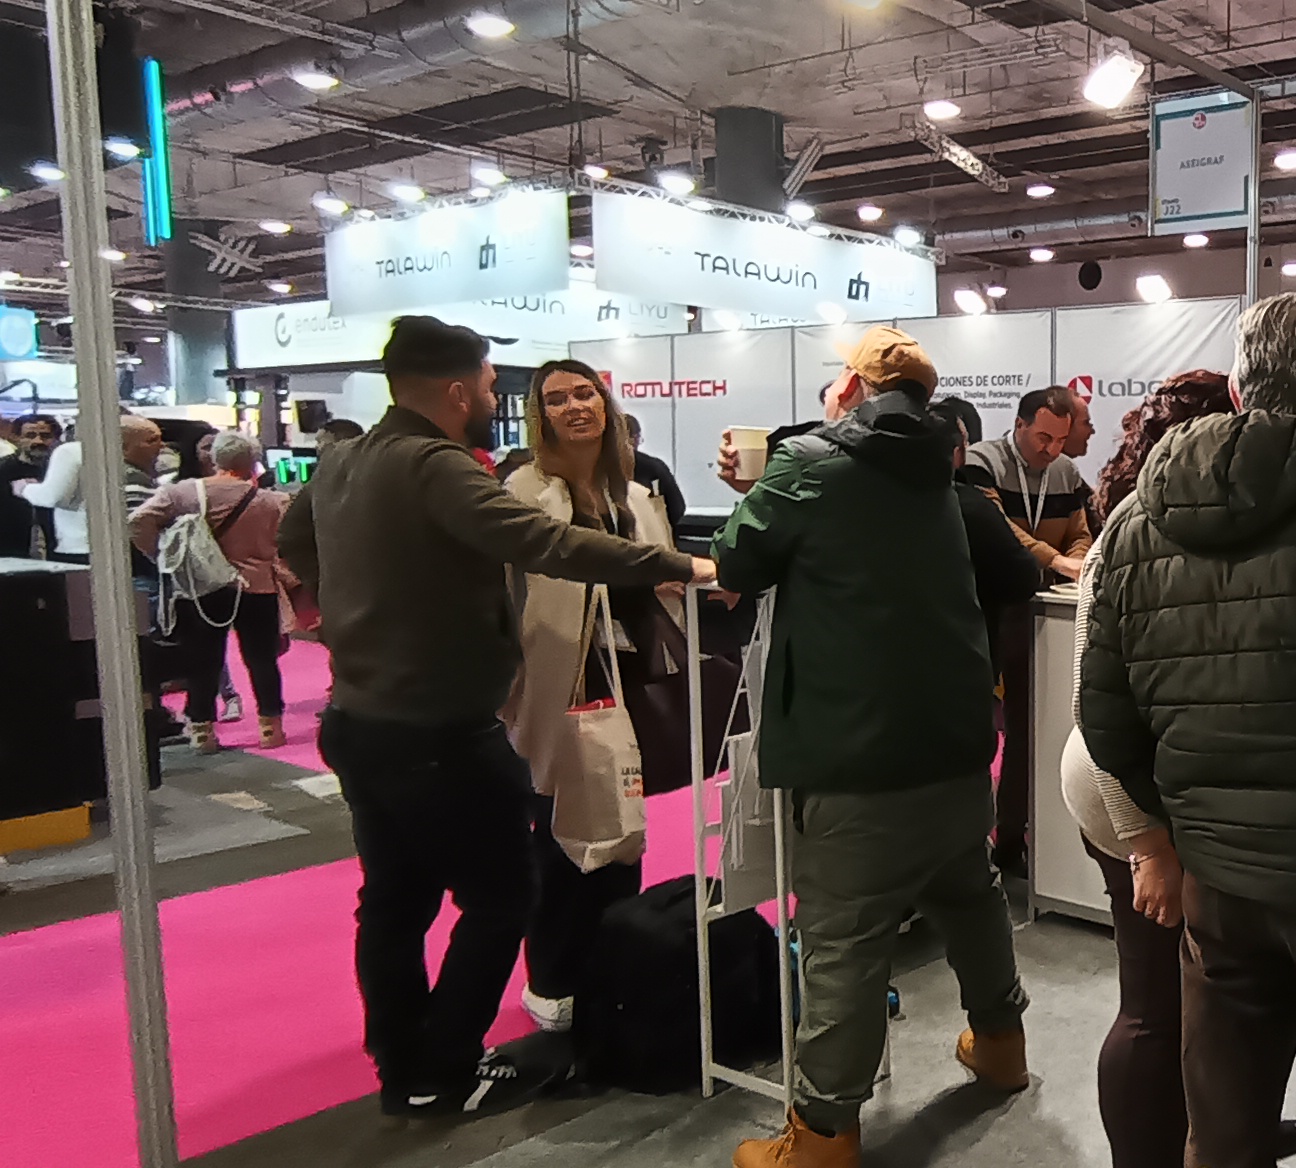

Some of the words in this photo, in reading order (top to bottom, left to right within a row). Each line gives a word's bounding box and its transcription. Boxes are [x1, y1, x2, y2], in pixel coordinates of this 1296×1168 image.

[1179, 155, 1225, 169] ASEIGRAF
[628, 303, 667, 319] LIYU
[938, 376, 974, 387] CIONES
[975, 375, 989, 387] DE
[991, 374, 1023, 387] CORTE
[621, 380, 727, 399] ROTUTECH
